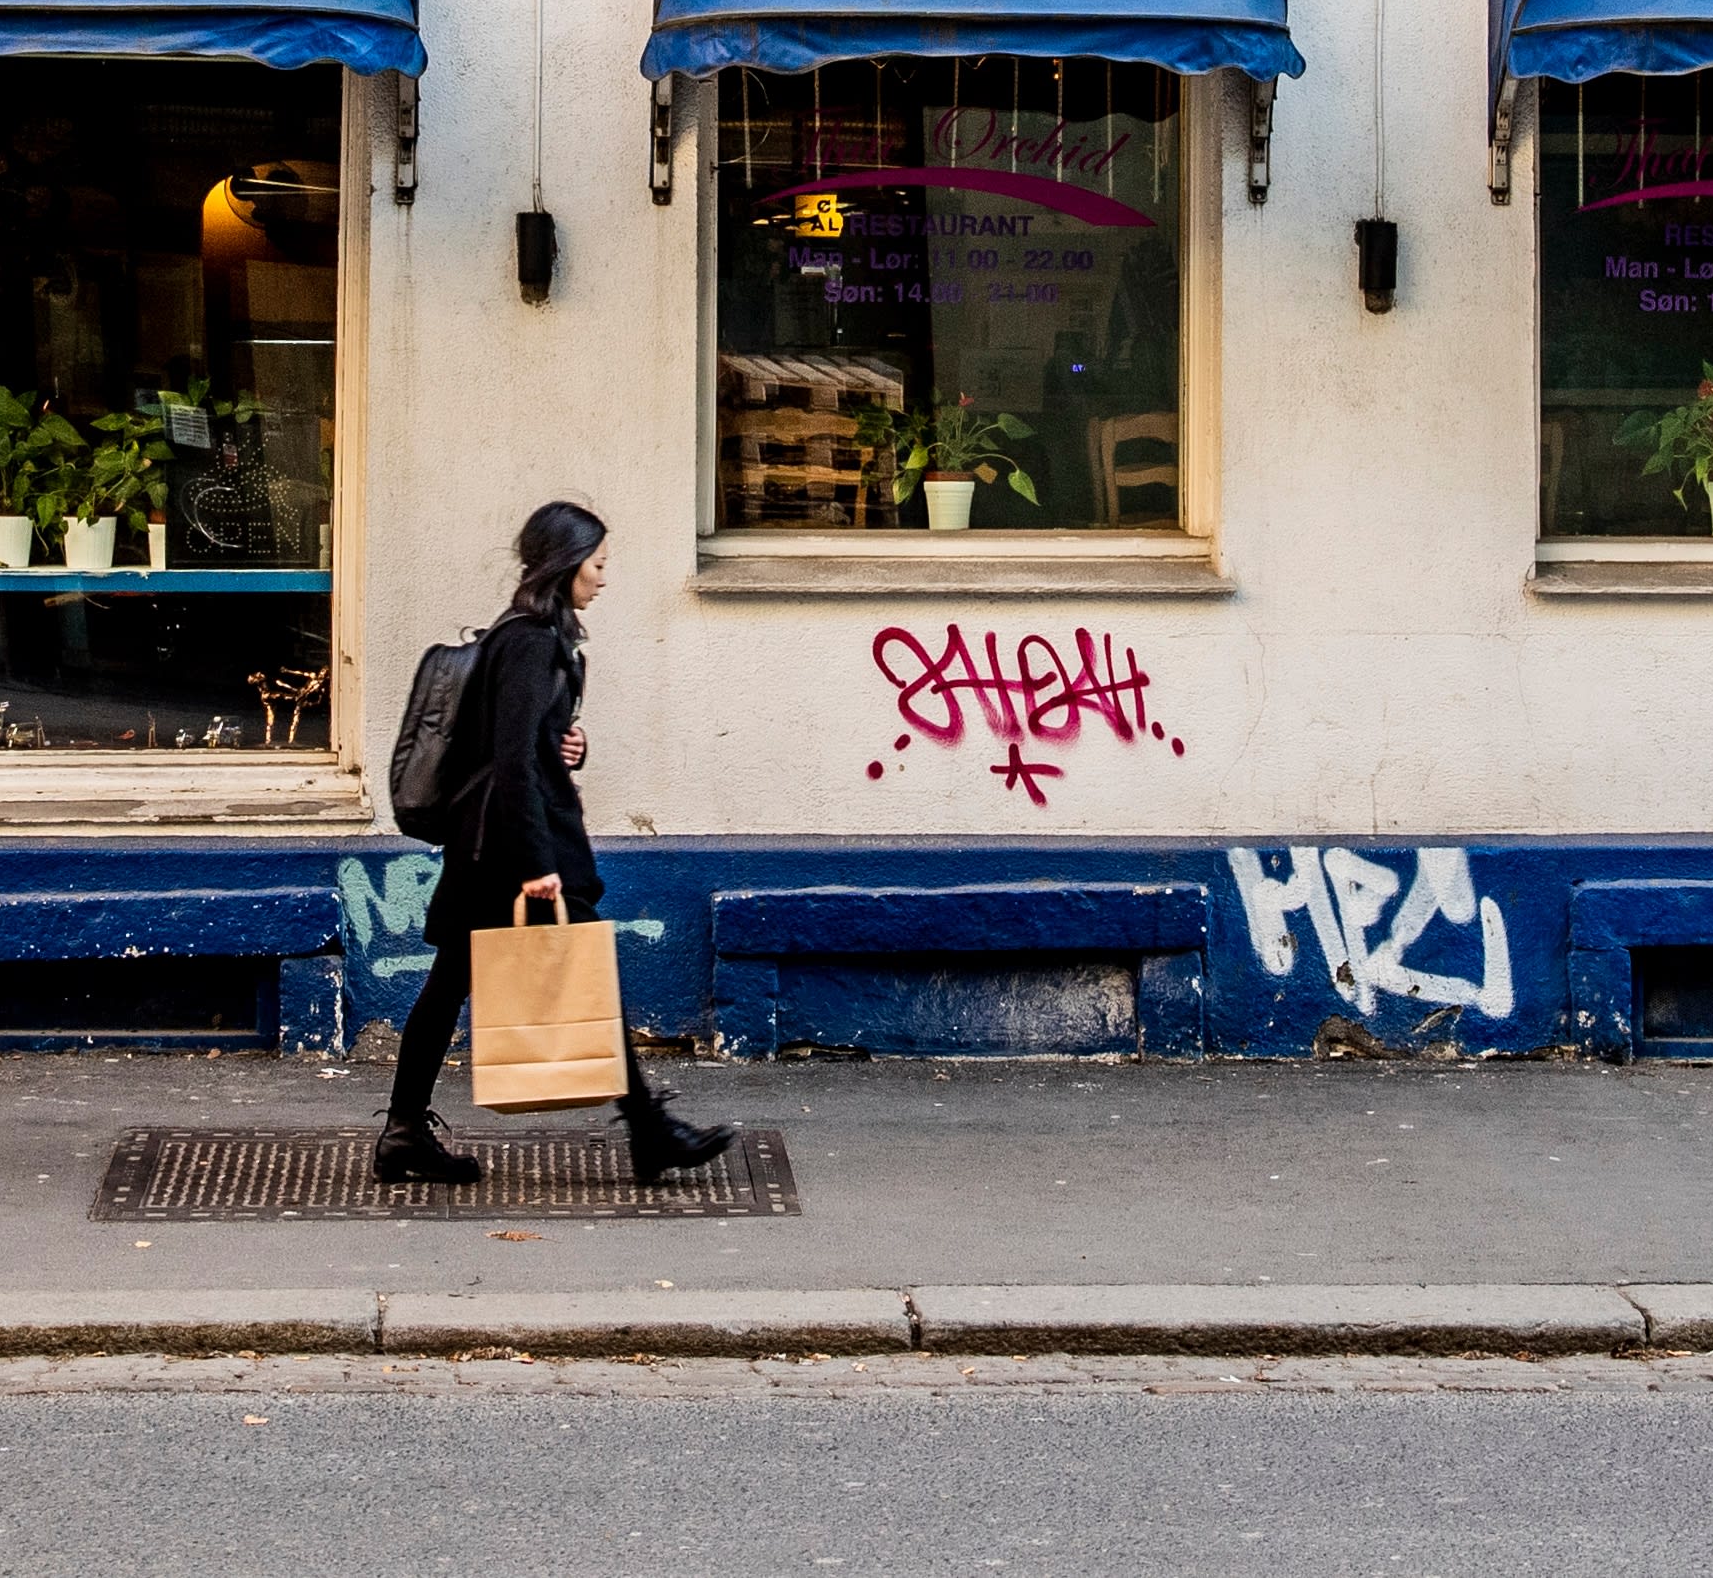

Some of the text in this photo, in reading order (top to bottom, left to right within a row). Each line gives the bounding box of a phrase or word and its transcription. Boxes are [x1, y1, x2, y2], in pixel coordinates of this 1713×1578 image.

[933, 103, 1132, 176] Orchid
[849, 213, 1035, 237] RESTAURANT
[788, 246, 844, 271] Man
[869, 247, 919, 271] Lør:
[1024, 249, 1095, 272] 22.00
[1604, 256, 1660, 279] Man
[824, 281, 885, 305] Søn:
[1638, 290, 1697, 314] Søn:
